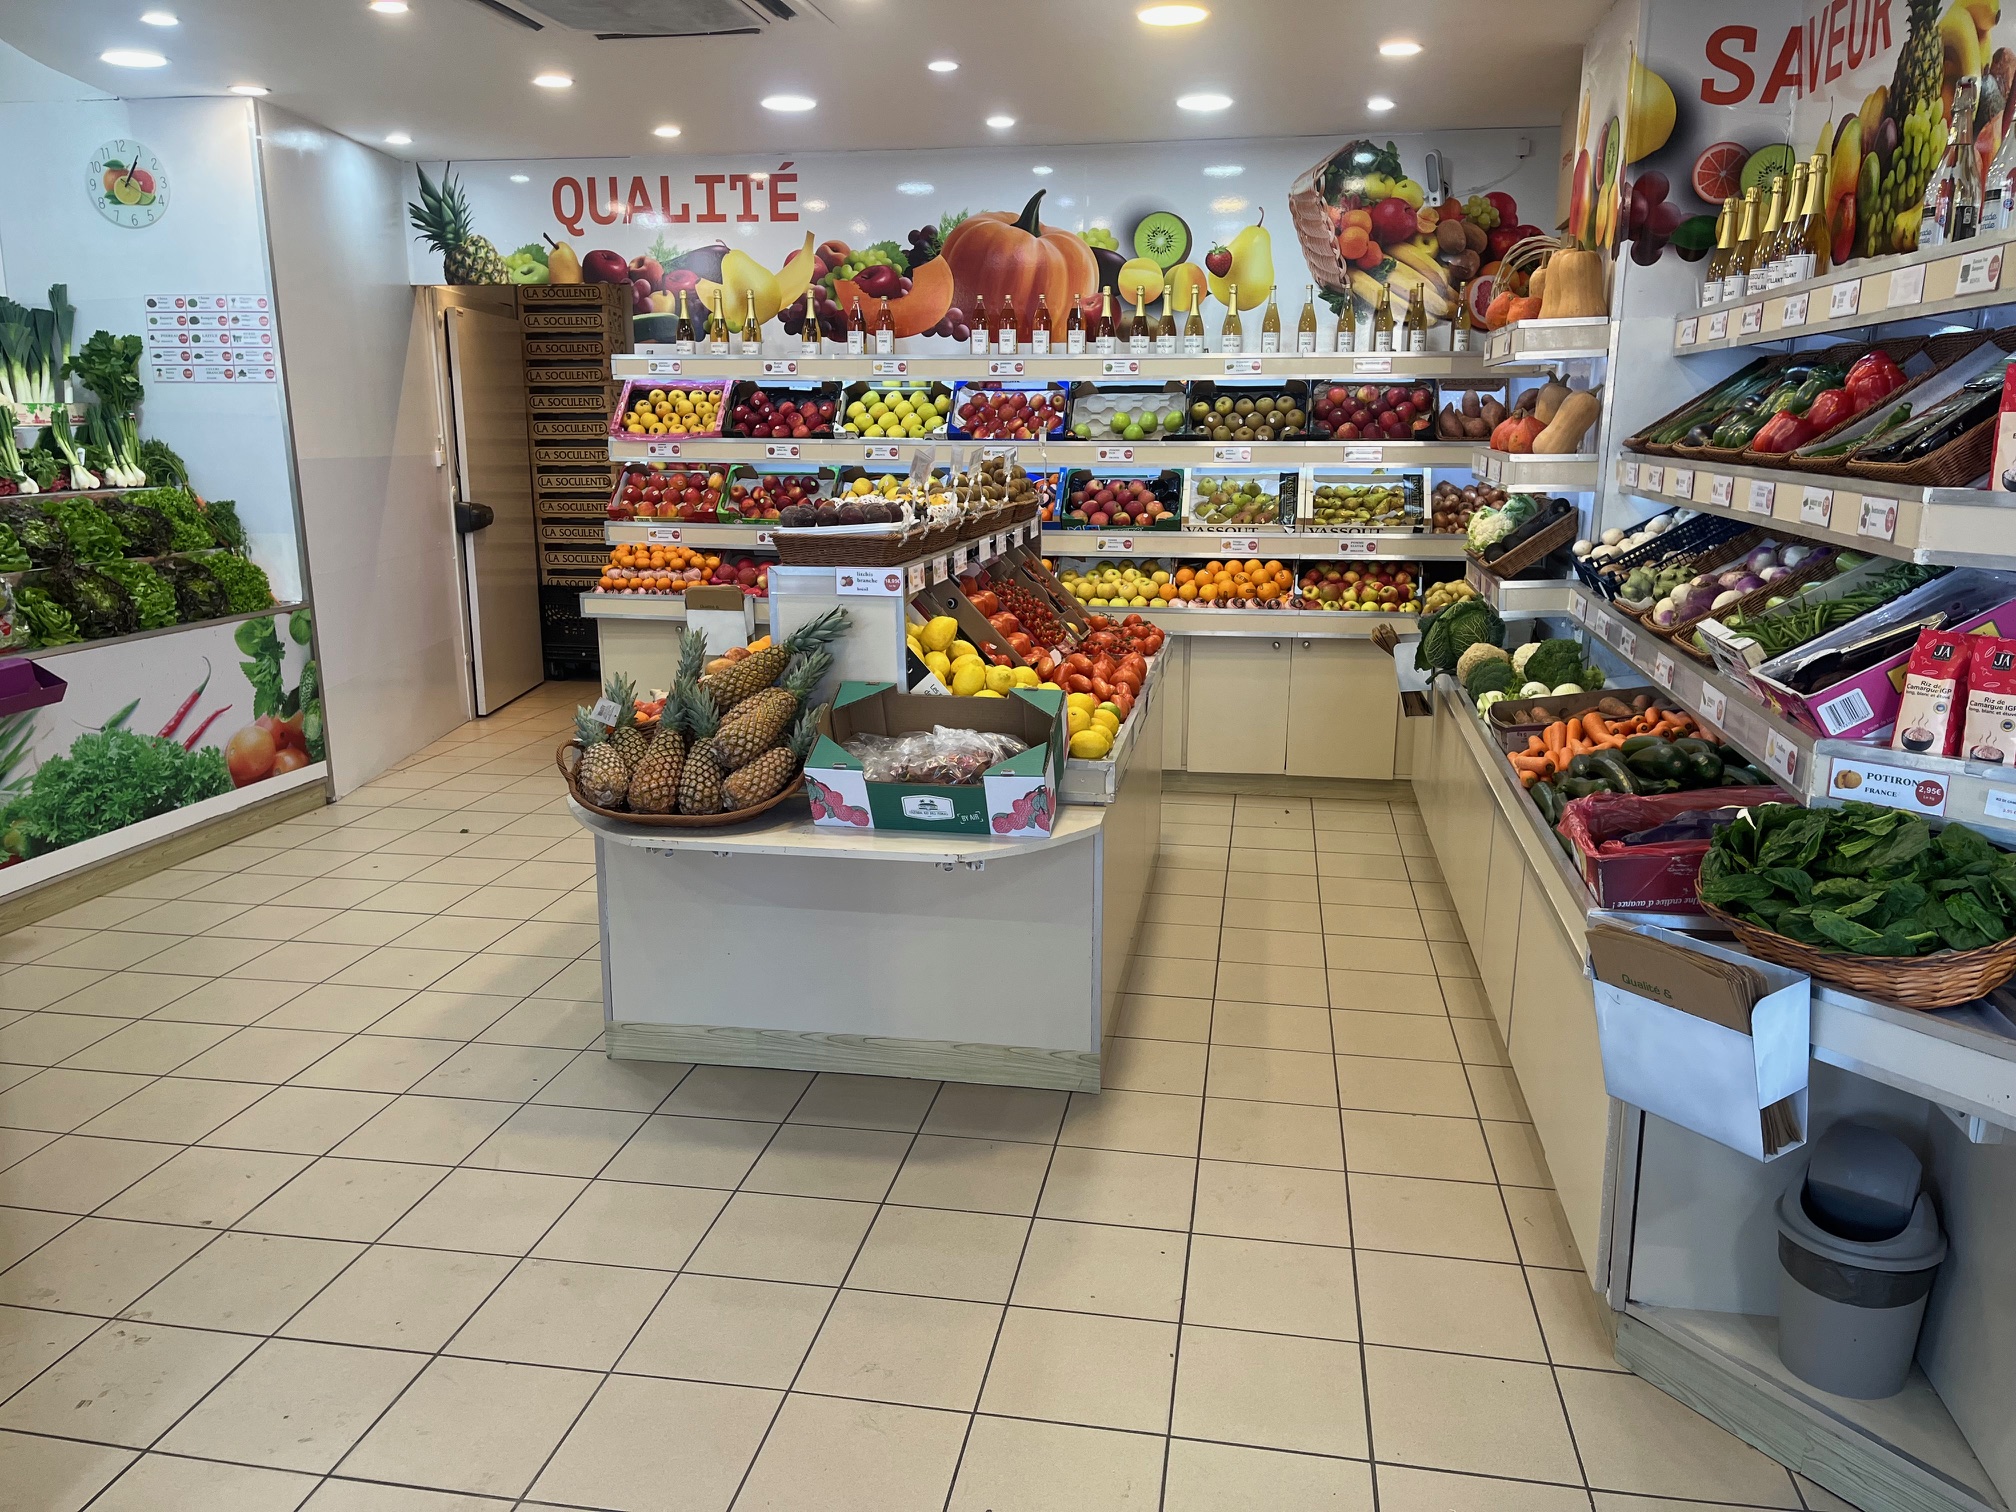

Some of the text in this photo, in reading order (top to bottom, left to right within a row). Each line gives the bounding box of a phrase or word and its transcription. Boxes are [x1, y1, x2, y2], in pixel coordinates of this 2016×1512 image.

[1700, 0, 1893, 105] SAVEUR
[115, 139, 126, 152] 12
[137, 145, 142, 158] 1
[100, 147, 110, 159] 11
[90, 160, 102, 174] 10
[151, 157, 158, 170] 2
[89, 178, 96, 190] 9
[160, 176, 167, 189] 3
[97, 197, 105, 209] 8
[158, 194, 165, 206] 4
[551, 161, 799, 237] QUALITÉ
[113, 210, 120, 222] 7
[131, 213, 138, 226] 6
[146, 209, 154, 221] 5
[526, 289, 598, 298] LA SOCULENTE
[528, 317, 599, 326] LA SOCULENTE
[530, 344, 600, 353] LA SOCULENTE
[530, 372, 600, 380] LA SOCULENTE
[532, 398, 601, 406] LA SOCULENTE
[536, 424, 604, 433] LA SOCULENTE
[538, 451, 606, 460] LA SOCULENTE
[541, 478, 609, 486] LA SOCULENTE
[542, 503, 554, 511] LA
[545, 529, 604, 538] LA SOCULENT
[548, 555, 559, 563] LA
[1906, 684, 1938, 694] Camargue
[1970, 700, 2004, 712] Camargue
[1866, 772, 1922, 788] POTIRON
[1864, 787, 1898, 798] FRANCE
[1918, 786, 1942, 796] 2,95€
[1656, 899, 1683, 908] endive
[1684, 898, 1701, 906] Une
[1621, 974, 1673, 1000] Qualité &
